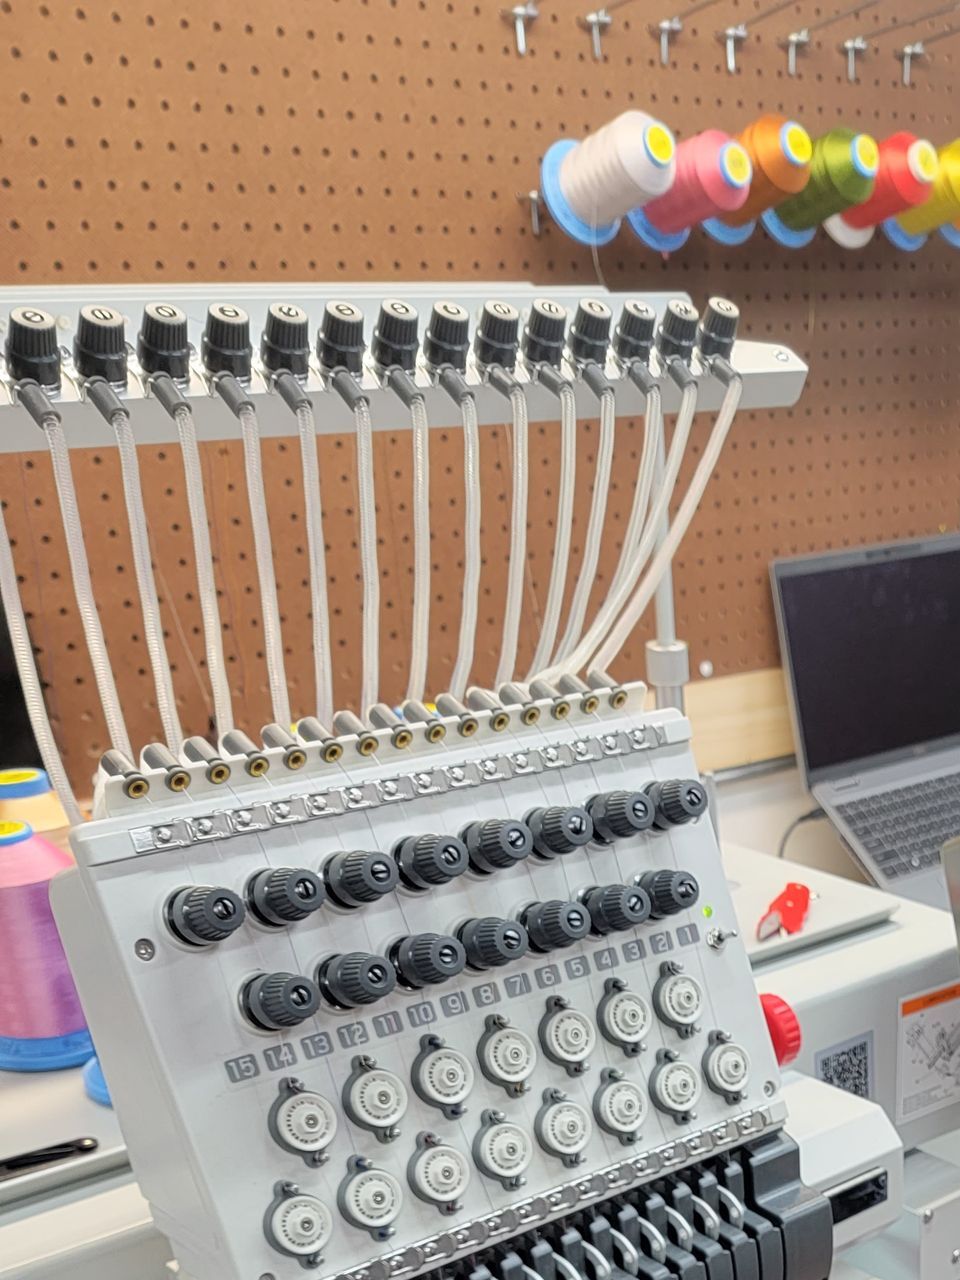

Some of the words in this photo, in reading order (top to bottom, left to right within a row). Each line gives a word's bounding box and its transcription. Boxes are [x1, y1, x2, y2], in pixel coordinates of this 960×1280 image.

[227, 1056, 258, 1080] 15
[265, 1047, 294, 1069] 14
[303, 1034, 330, 1058] 13
[340, 1023, 367, 1046] 12
[375, 1013, 398, 1035] 11
[410, 1004, 434, 1025] 10
